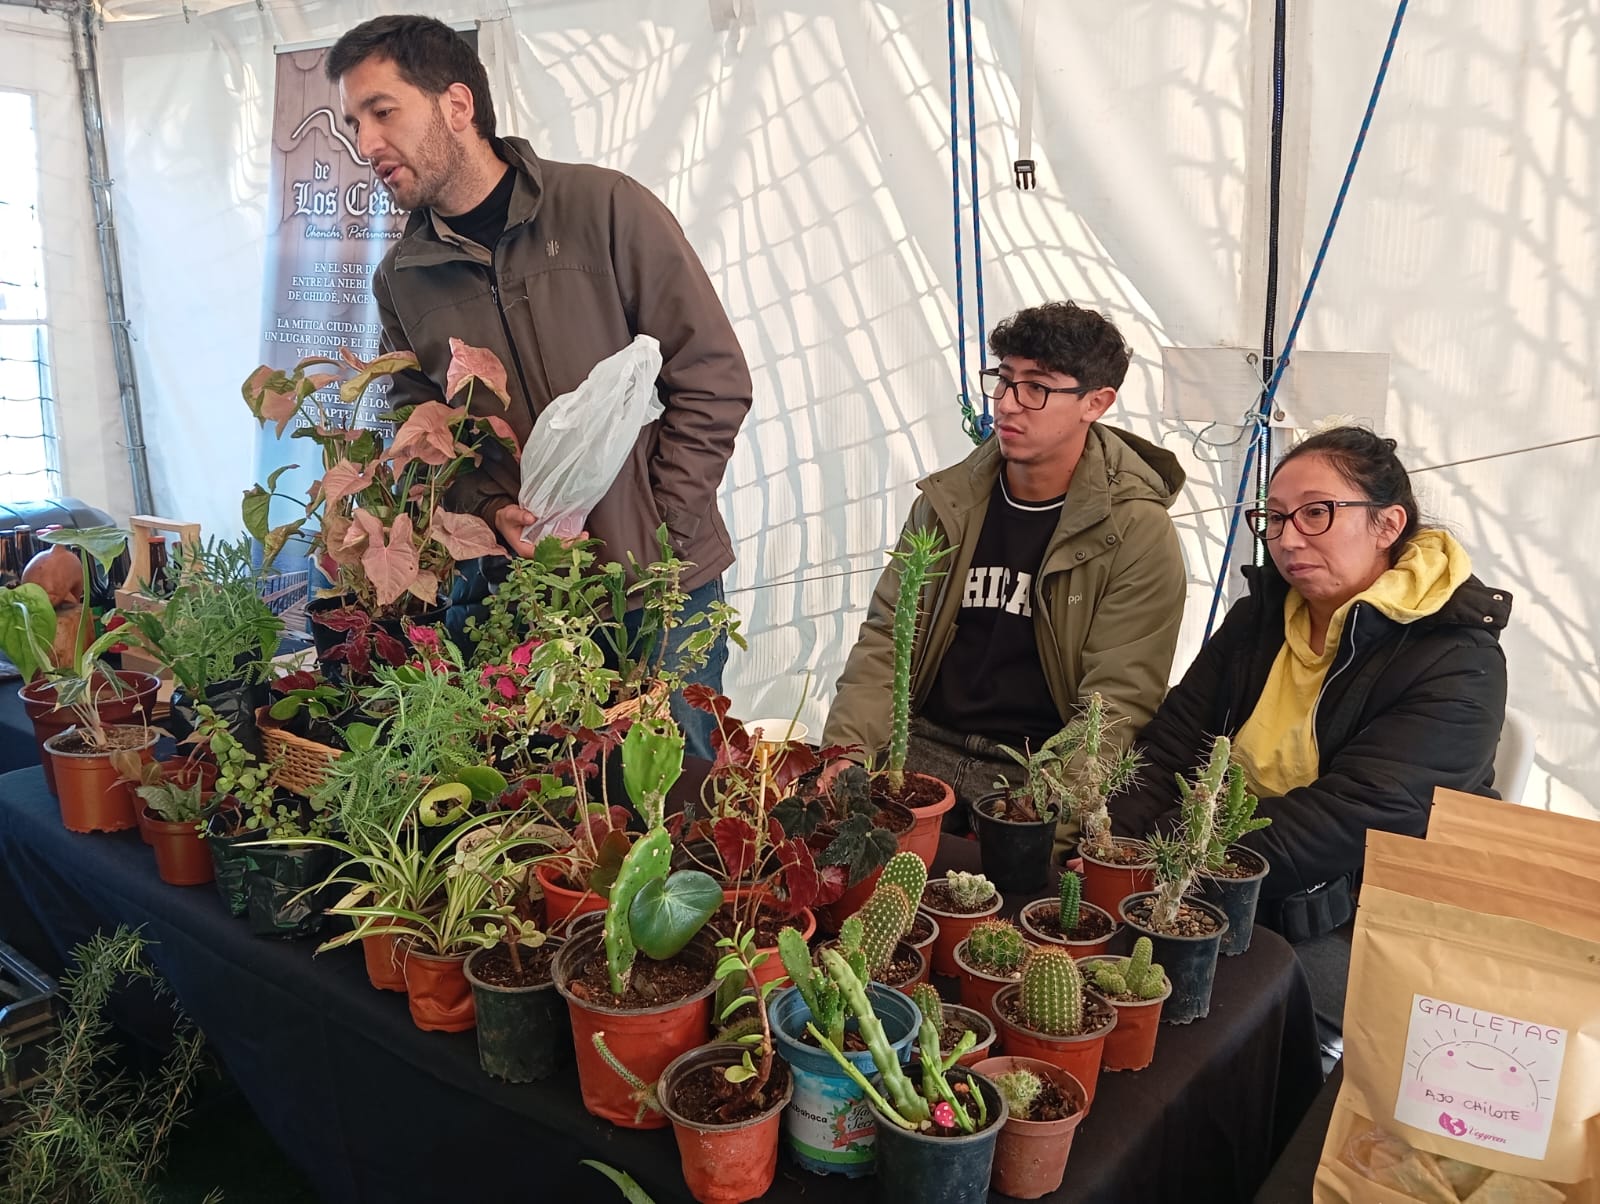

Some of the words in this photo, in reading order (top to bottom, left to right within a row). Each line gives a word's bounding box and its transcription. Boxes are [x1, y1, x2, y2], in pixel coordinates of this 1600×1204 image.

[314, 160, 330, 180] de
[293, 181, 338, 216] Los
[345, 178, 411, 217] Cés
[347, 225, 403, 240] Patrimonio
[315, 263, 327, 273] EN
[328, 263, 340, 274] EL
[342, 263, 363, 275] SUR
[292, 276, 323, 287] ENTRE
[324, 277, 335, 288] LA
[288, 290, 301, 301] DE
[303, 290, 340, 304] CHILOÉ,
[342, 293, 369, 304] NACE
[277, 318, 290, 329] LA
[292, 316, 324, 331] MÍTICA
[326, 321, 365, 333] CIUDAD
[367, 324, 379, 334] DE
[264, 331, 277, 342] UN
[280, 333, 311, 344] LUGAR
[313, 335, 348, 347] DONDE
[351, 338, 363, 348] EL
[365, 339, 379, 349] TIE
[296, 348, 304, 358] Y
[304, 349, 316, 358] LA
[319, 350, 369, 361] FELICAD
[311, 392, 355, 405] ERVE
[317, 407, 363, 421] CAPTUA
[364, 412, 377, 422] LA
[962, 566, 1032, 618] HICA
[1418, 998, 1561, 1045] GALLETAS
[1425, 1088, 1454, 1104] AJO
[792, 1104, 828, 1123] bahaca
